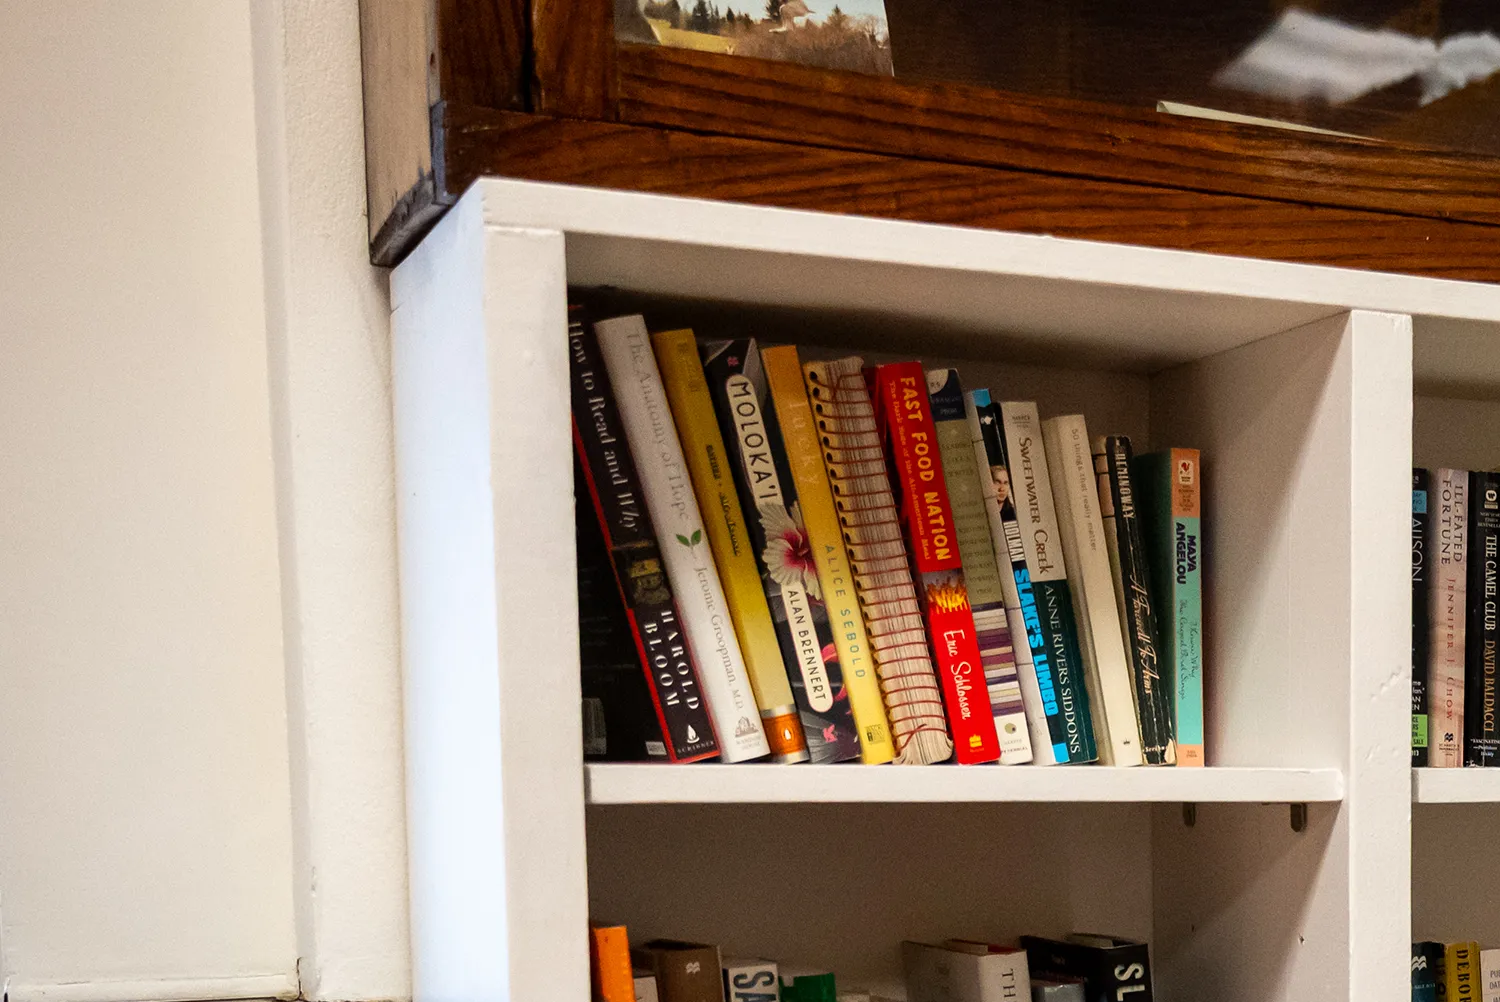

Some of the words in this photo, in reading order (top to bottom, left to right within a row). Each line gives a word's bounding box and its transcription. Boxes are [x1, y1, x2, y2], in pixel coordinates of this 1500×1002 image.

[900, 377, 923, 423] FAST
[911, 431, 935, 482] FOOD
[924, 492, 952, 561] NATION
[1441, 480, 1452, 565] FORTUNE
[1453, 485, 1463, 562] ILL-FATED
[1485, 535, 1497, 557] THE
[1176, 522, 1187, 585] ANGELOU
[1187, 535, 1196, 573] MAYA
[1485, 561, 1497, 599] CAMEL
[825, 545, 846, 597] ALICE
[841, 608, 866, 678] SEBOLD
[1044, 585, 1061, 630] ANNE
[1484, 601, 1496, 631] CLUB
[644, 623, 680, 706] BLOOM
[661, 611, 700, 710] HAROLD
[788, 590, 805, 625] ALAN
[798, 630, 826, 700] BRENNERT
[1052, 633, 1070, 685] RIVERS
[1484, 640, 1496, 675] DAVID
[1062, 688, 1081, 755] SIDDONS
[1483, 679, 1495, 732] BALDACCI
